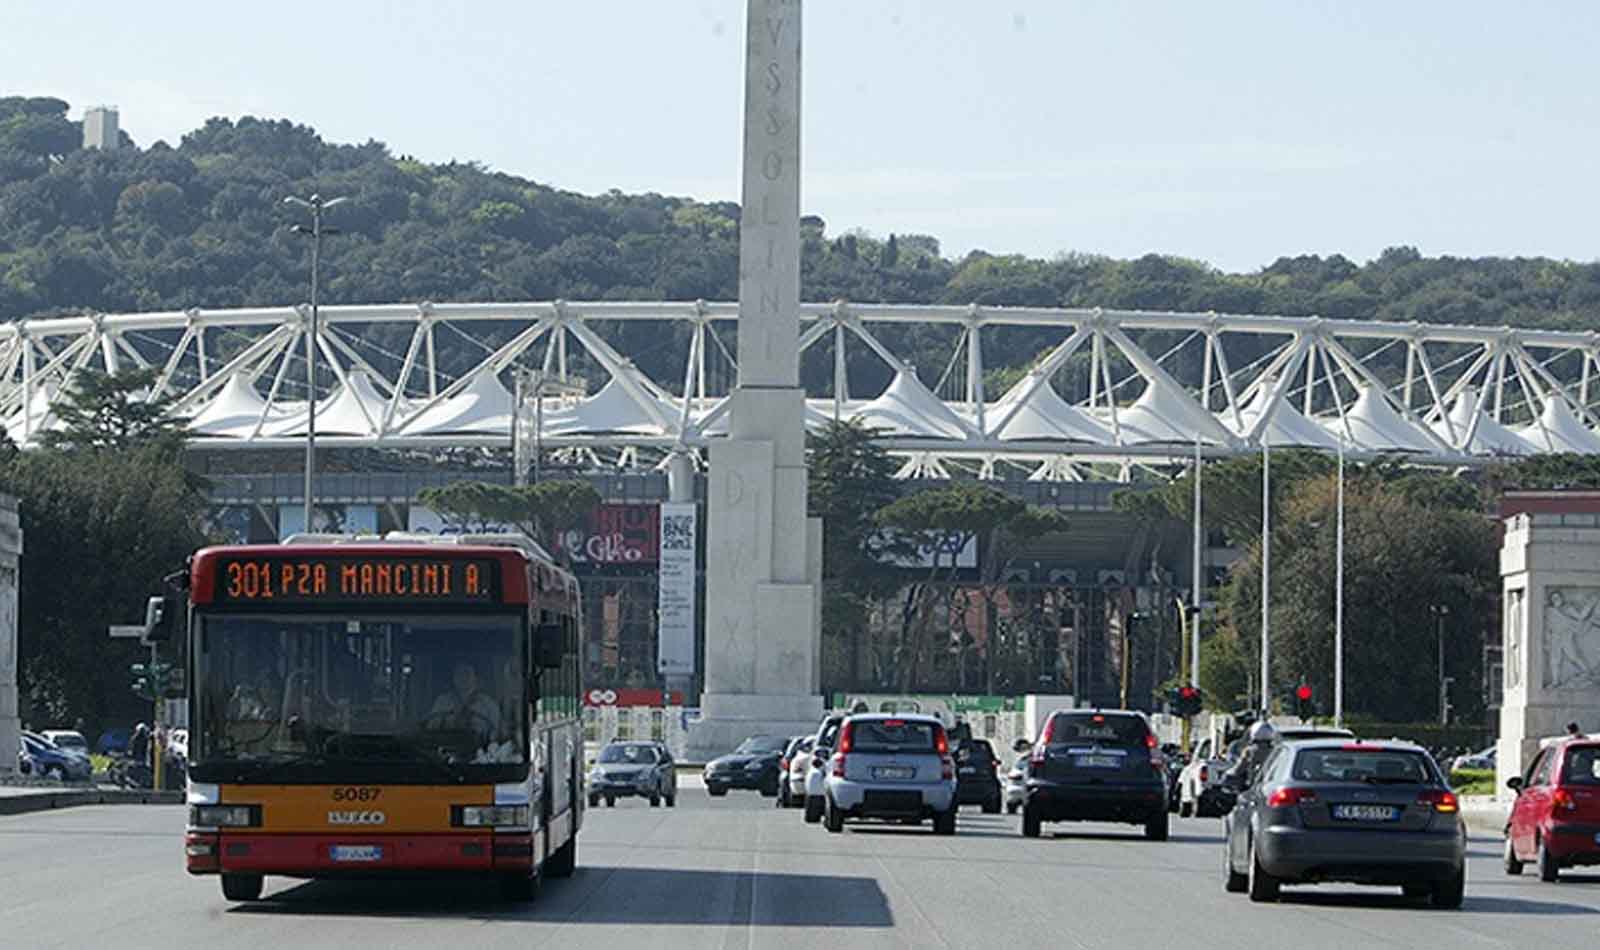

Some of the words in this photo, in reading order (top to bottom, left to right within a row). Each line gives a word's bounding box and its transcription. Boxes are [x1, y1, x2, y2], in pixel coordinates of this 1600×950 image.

[760, 0, 785, 361] VSSOLINI
[227, 561, 273, 598] 301
[341, 563, 451, 595] MANCINI
[333, 787, 381, 801] 5087
